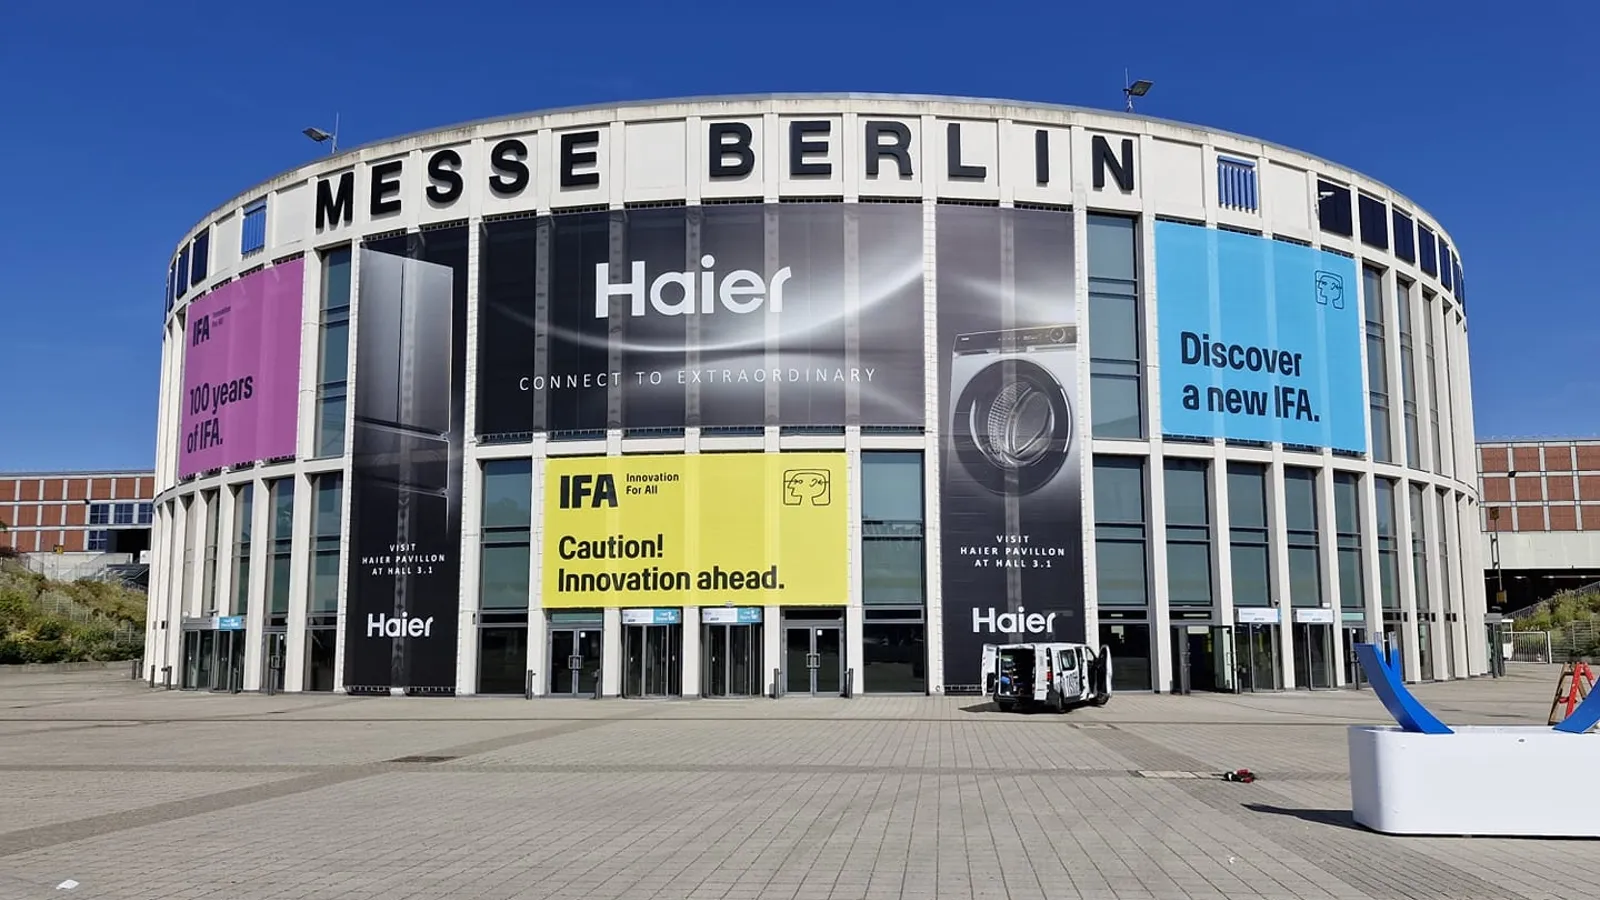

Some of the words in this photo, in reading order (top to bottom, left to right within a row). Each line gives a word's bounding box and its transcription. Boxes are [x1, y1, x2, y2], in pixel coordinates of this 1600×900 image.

[315, 131, 600, 230] MESSE
[708, 120, 1134, 190] BERLIN
[595, 254, 792, 318] Haier
[193, 315, 210, 347] IFA
[1180, 331, 1302, 377] Discover
[519, 373, 621, 391] CONNECT
[636, 371, 662, 385] TO
[678, 368, 875, 384] EXTRAORDINARY
[190, 383, 210, 416] 100
[212, 376, 253, 415] years
[1182, 385, 1199, 410] a
[1207, 387, 1268, 416] new
[1274, 386, 1320, 422] IFA.
[187, 424, 199, 453] of
[200, 418, 223, 450] IFA.
[626, 472, 679, 483] Innovation
[626, 486, 642, 495] For
[644, 485, 658, 495] All
[559, 474, 618, 509] IFA
[389, 543, 416, 552] VISIT
[558, 534, 663, 560] Caution!
[960, 547, 998, 555] HAIER
[1005, 548, 1065, 556] PAVILLON
[996, 535, 1029, 543] VISIT
[362, 556, 390, 564] HAIER
[395, 554, 445, 563] PAVILLON
[372, 567, 383, 575] AT
[388, 567, 412, 575] HALL
[417, 566, 432, 574] 3.1
[1033, 560, 1051, 568] 3.1
[558, 567, 690, 592] Innovation
[697, 565, 785, 590] ahead.
[367, 612, 434, 637] Haier
[973, 606, 1056, 633] Haier
